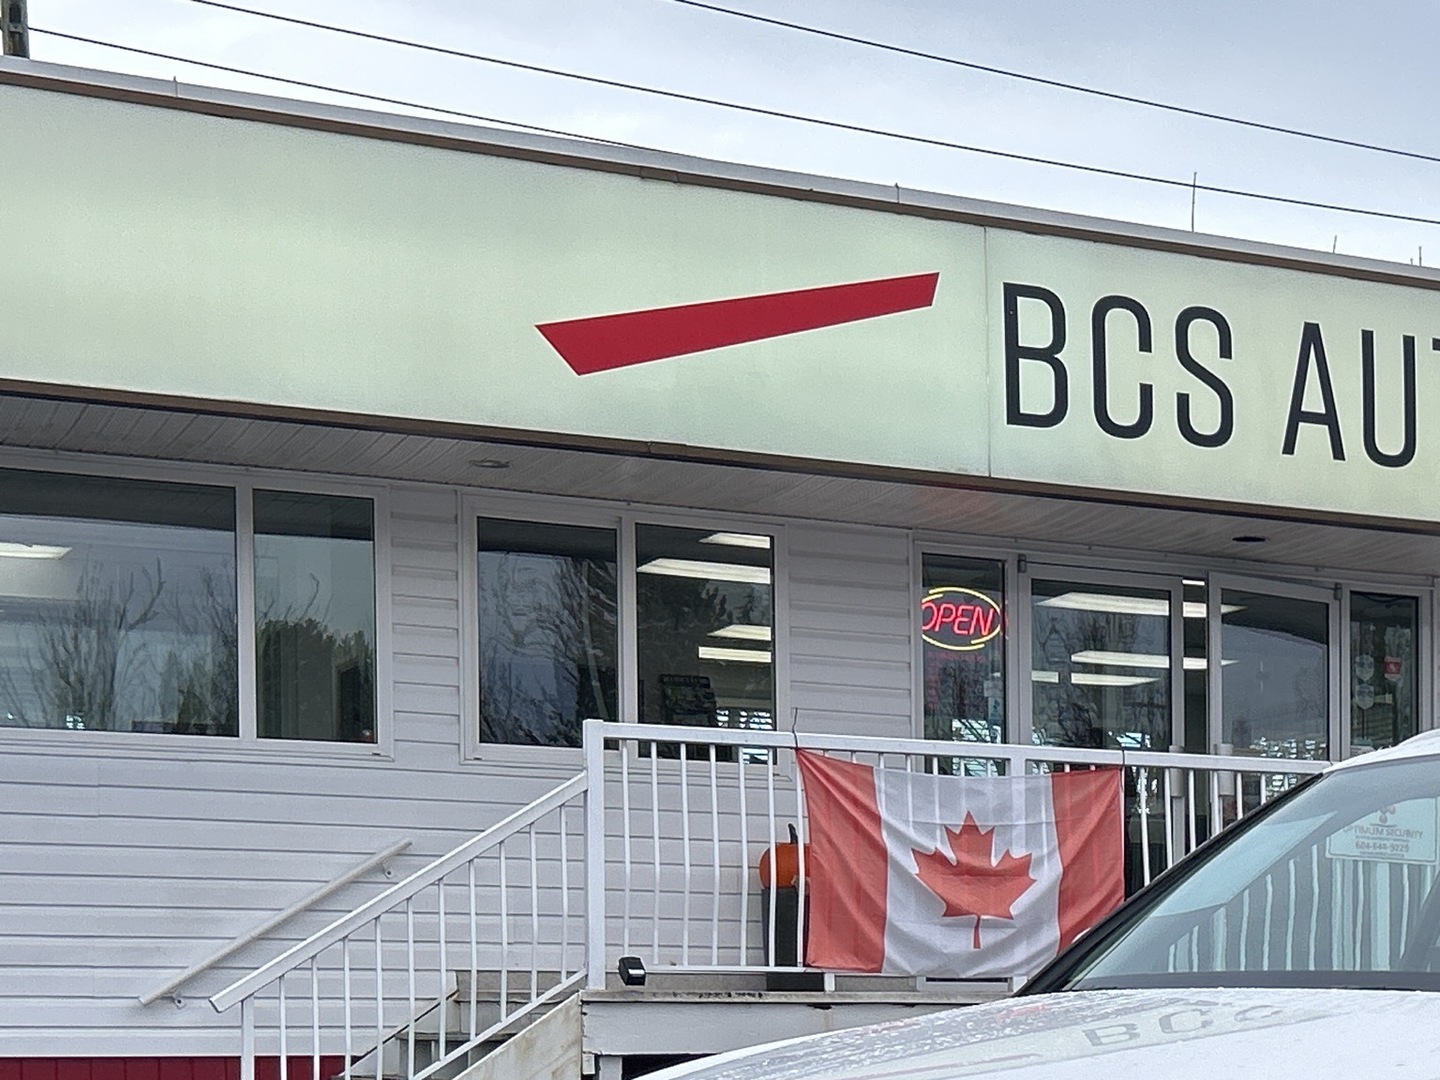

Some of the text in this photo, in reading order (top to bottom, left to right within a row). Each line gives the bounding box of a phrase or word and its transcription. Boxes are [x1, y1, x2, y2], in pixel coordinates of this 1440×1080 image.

[1002, 282, 1234, 447] BCS
[921, 602, 994, 635] OPEN
[1386, 827, 1423, 840] SECURITY
